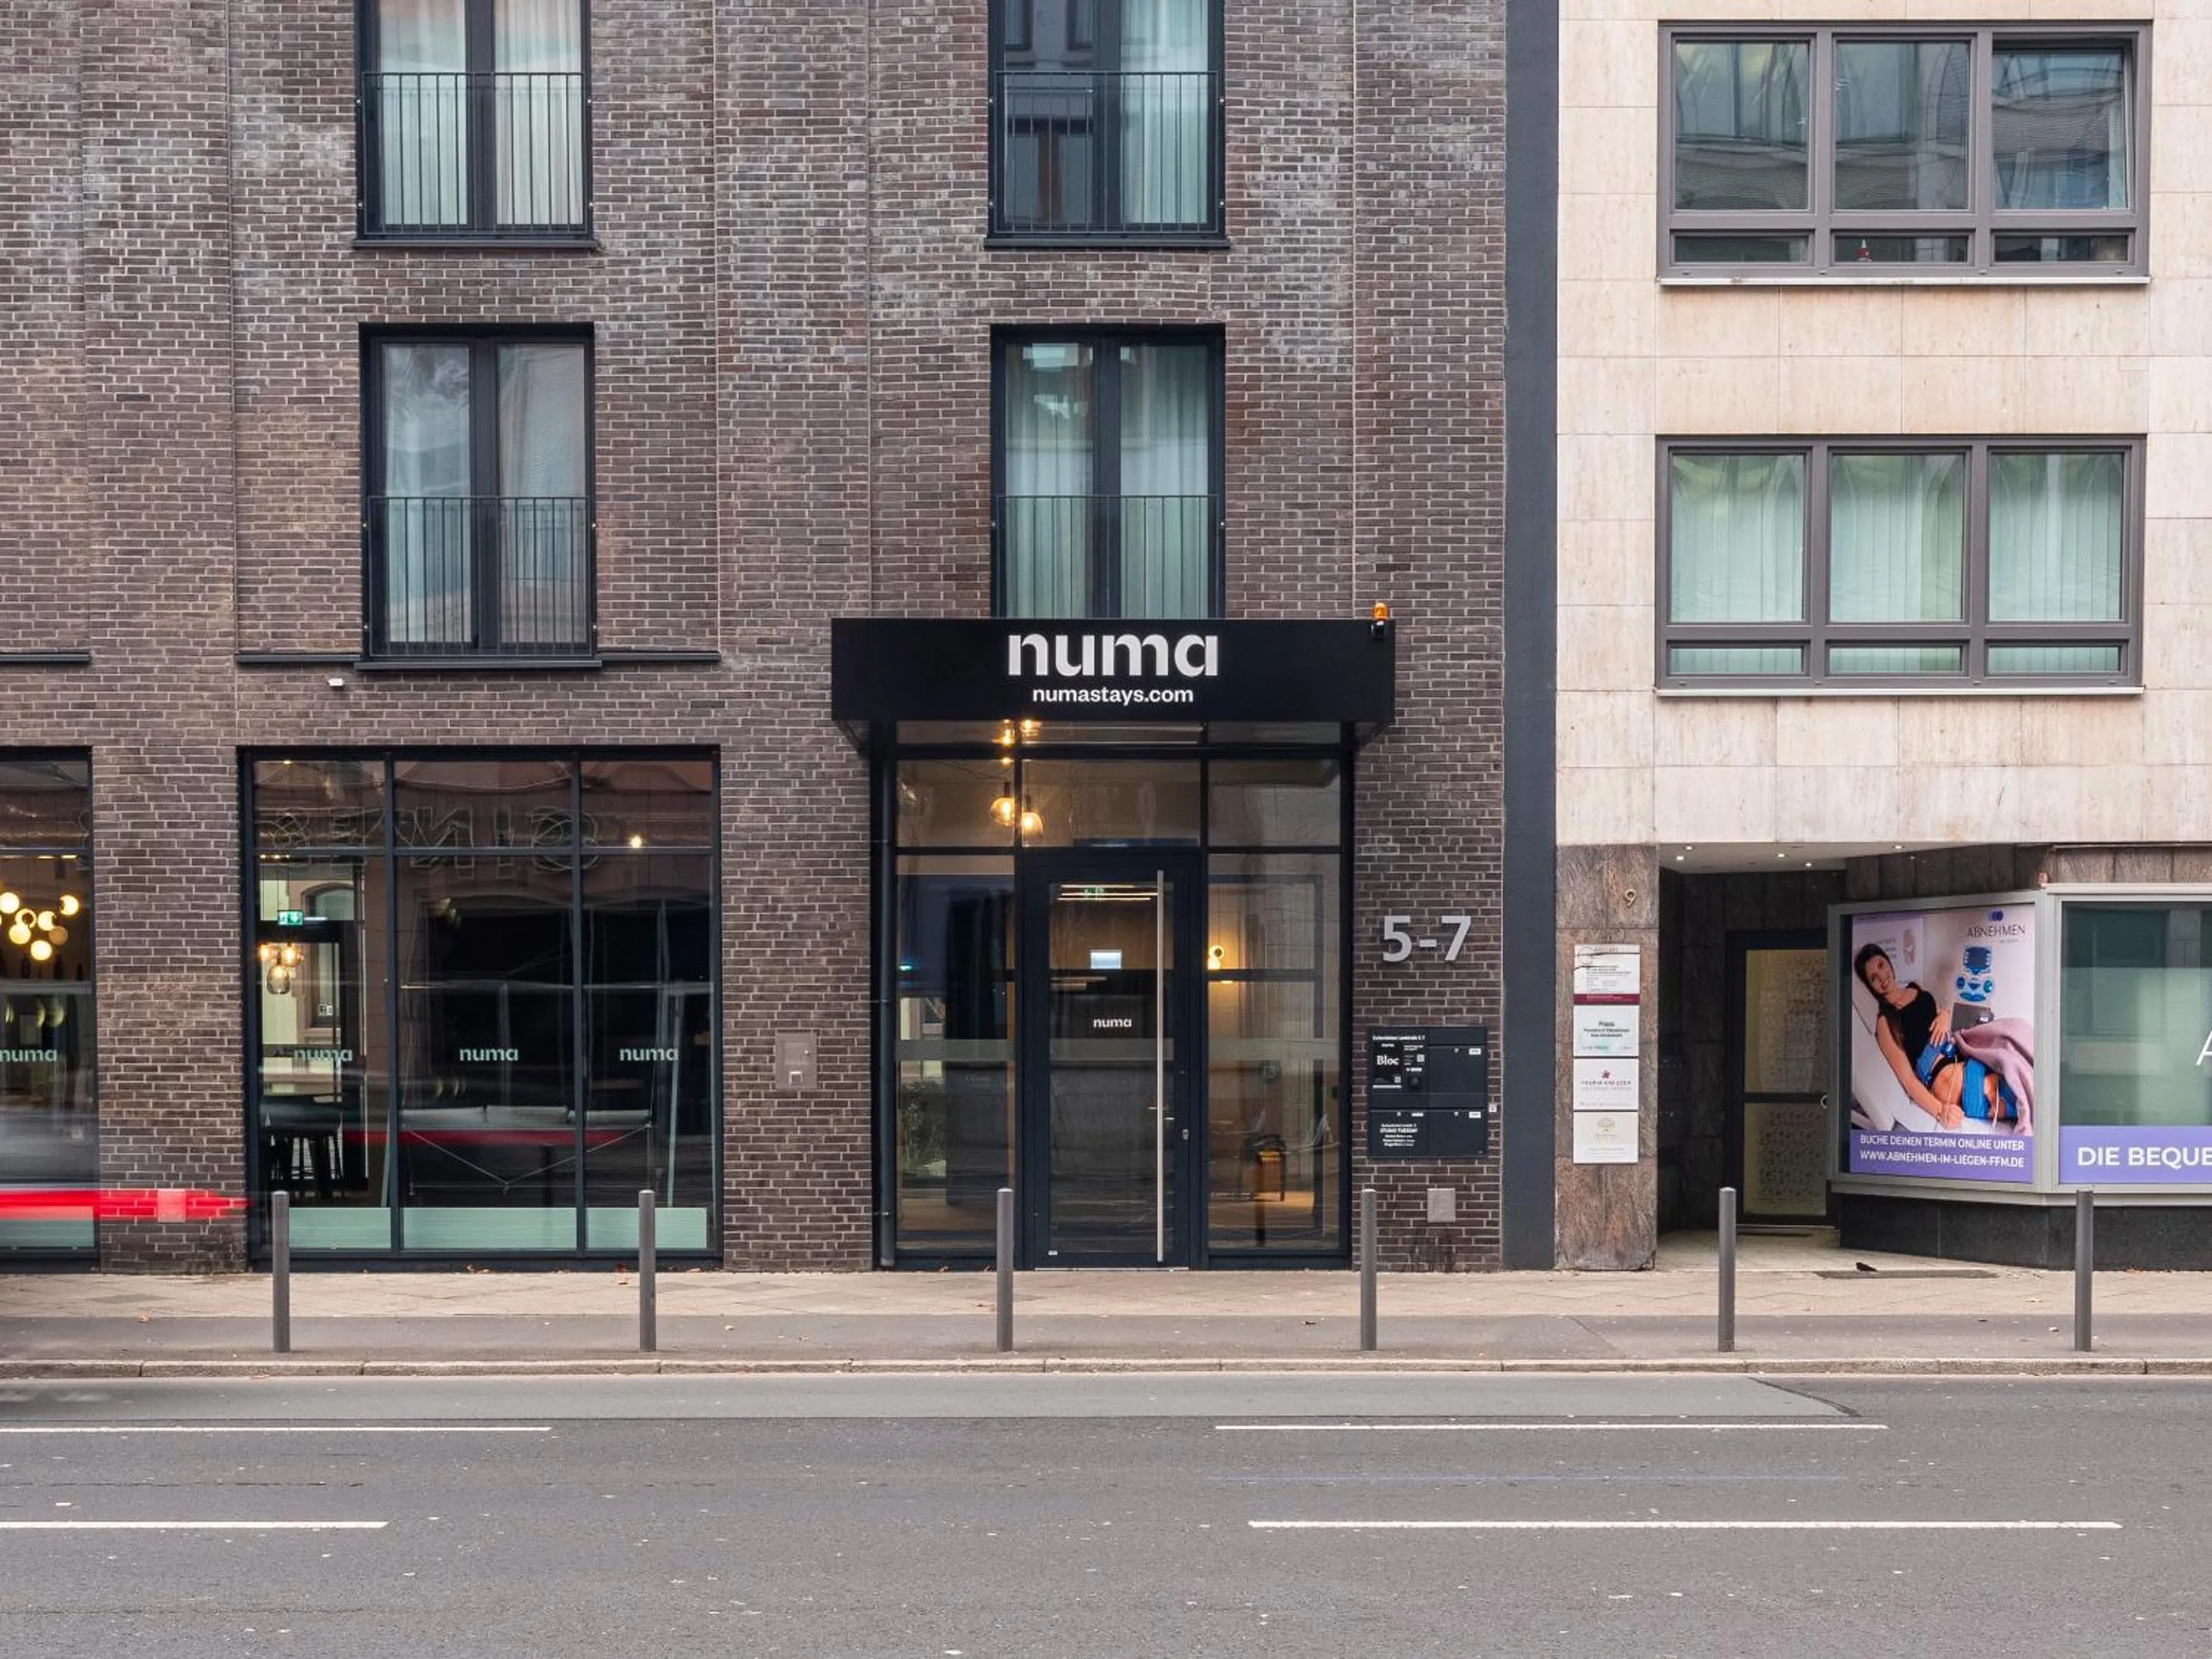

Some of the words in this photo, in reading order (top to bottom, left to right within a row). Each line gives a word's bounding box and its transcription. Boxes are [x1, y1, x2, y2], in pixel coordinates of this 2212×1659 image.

[1008, 634, 1218, 677] numa
[1032, 687, 1194, 706] numastays.com
[1967, 924, 2025, 938] ABNEHMEN
[1382, 916, 1471, 962] 5-7
[1093, 1018, 1132, 1028] numa
[0, 1049, 58, 1061] numa
[294, 1049, 353, 1061] numa
[459, 1048, 518, 1061] numa
[620, 1048, 679, 1061] numa
[1860, 1134, 1889, 1144] BUCHE
[1890, 1135, 1922, 1146] DEINEN
[1923, 1137, 1956, 1147] TERMIN
[1959, 1138, 1992, 1149] ONLINE
[1994, 1140, 2025, 1151] UNTER
[2077, 1147, 2120, 1166] DIE
